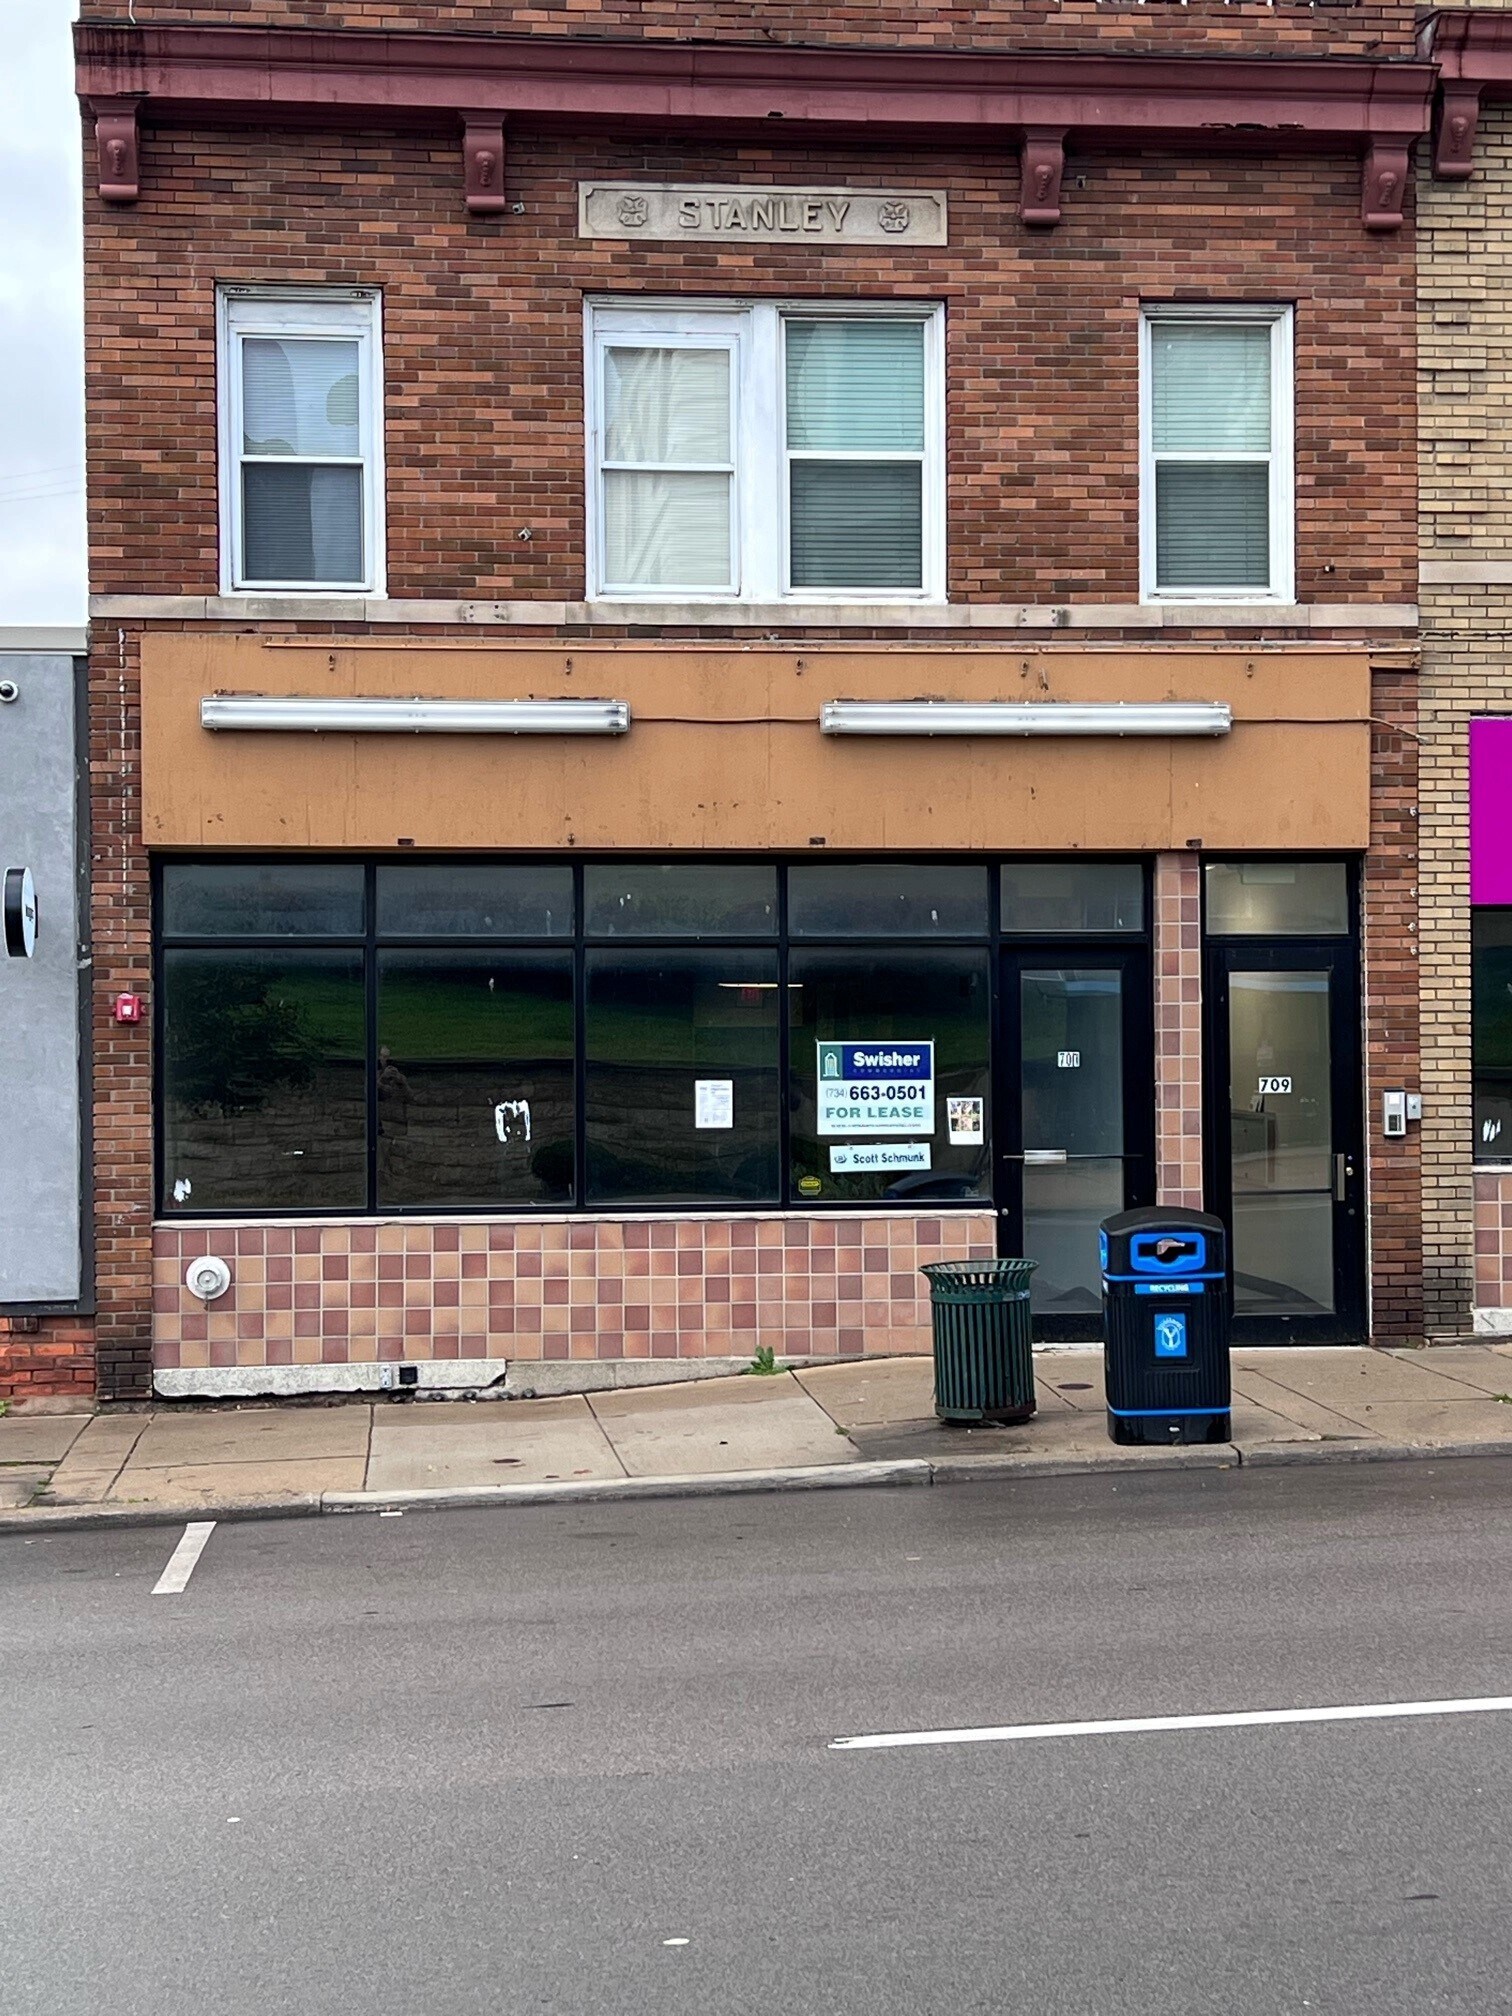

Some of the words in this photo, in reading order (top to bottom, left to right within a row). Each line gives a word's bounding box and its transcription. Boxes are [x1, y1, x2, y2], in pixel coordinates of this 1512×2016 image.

[678, 198, 851, 231] STANLEY
[853, 1051, 921, 1067] Swisher
[1260, 1078, 1290, 1092] 709
[825, 1087, 848, 1098] (734)
[826, 1107, 861, 1118] FOR
[867, 1107, 924, 1118] LEASE
[853, 1154, 878, 1164] Scott
[882, 1153, 925, 1163] Schmunk
